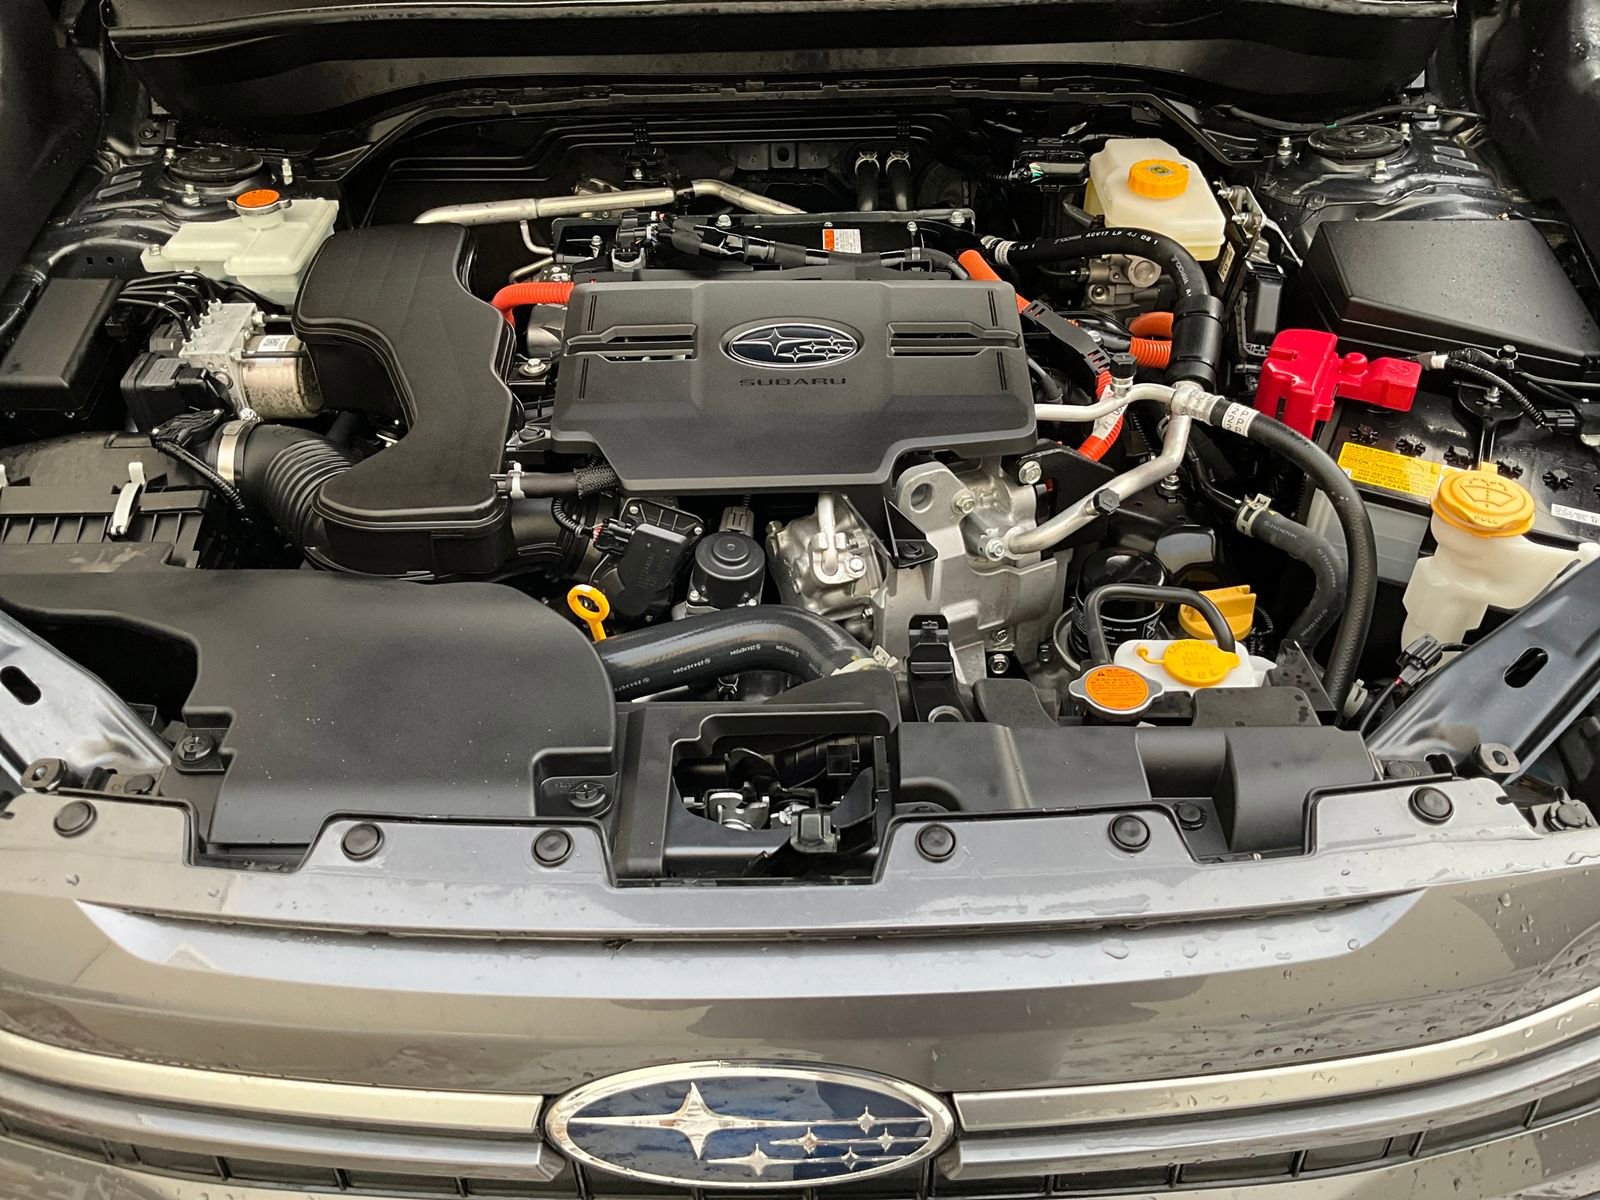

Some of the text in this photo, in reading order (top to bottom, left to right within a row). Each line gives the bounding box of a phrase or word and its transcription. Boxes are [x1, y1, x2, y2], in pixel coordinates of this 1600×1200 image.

[1086, 230, 1109, 238] ACV17
[738, 377, 847, 387] SUBARU
[1342, 455, 1369, 465] POISON
